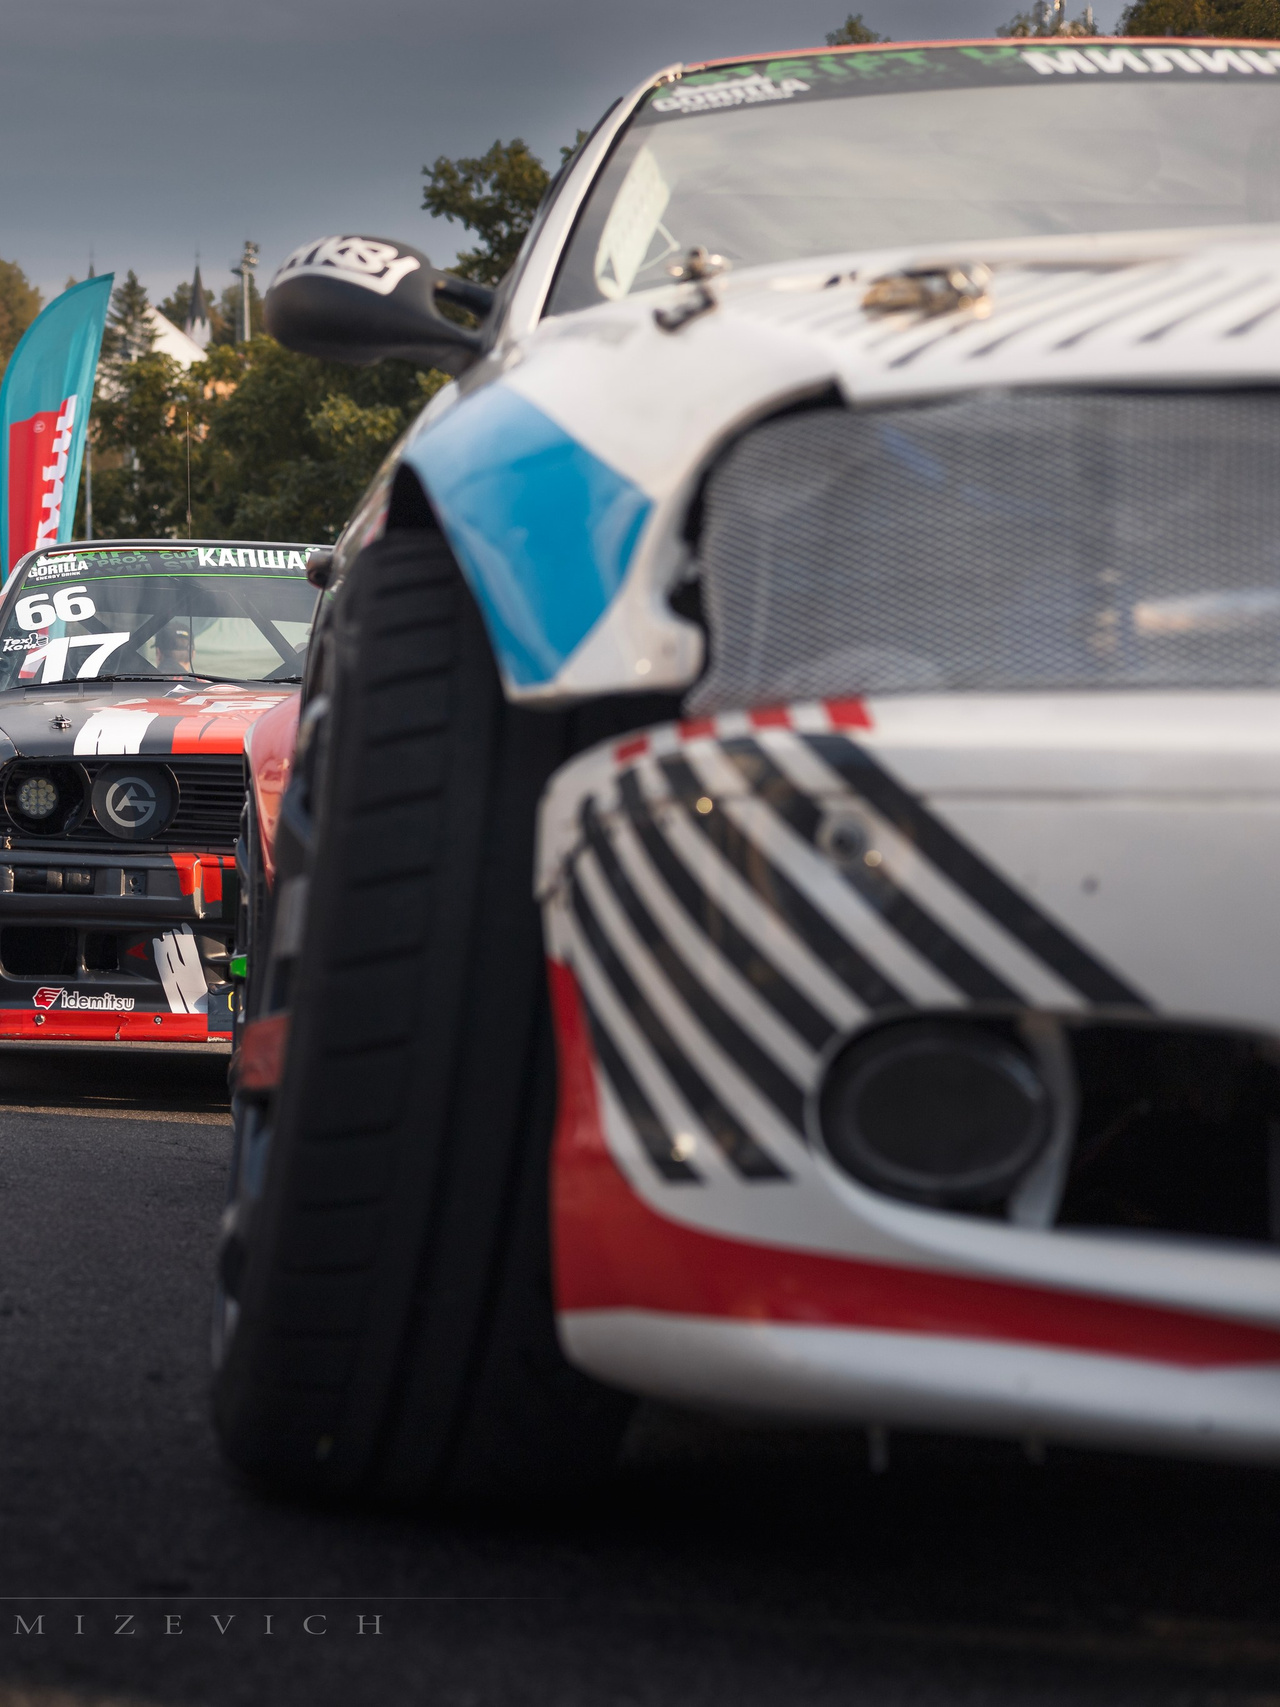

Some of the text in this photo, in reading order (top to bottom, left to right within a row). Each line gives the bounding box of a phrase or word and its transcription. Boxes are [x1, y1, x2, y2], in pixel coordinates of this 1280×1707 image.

[28, 560, 88, 578] GORILLA
[198, 547, 320, 570] КАПША
[36, 573, 61, 581] ENERGY
[15, 586, 96, 631] 66
[18, 632, 130, 684] 17
[61, 991, 135, 1012] idemitsu
